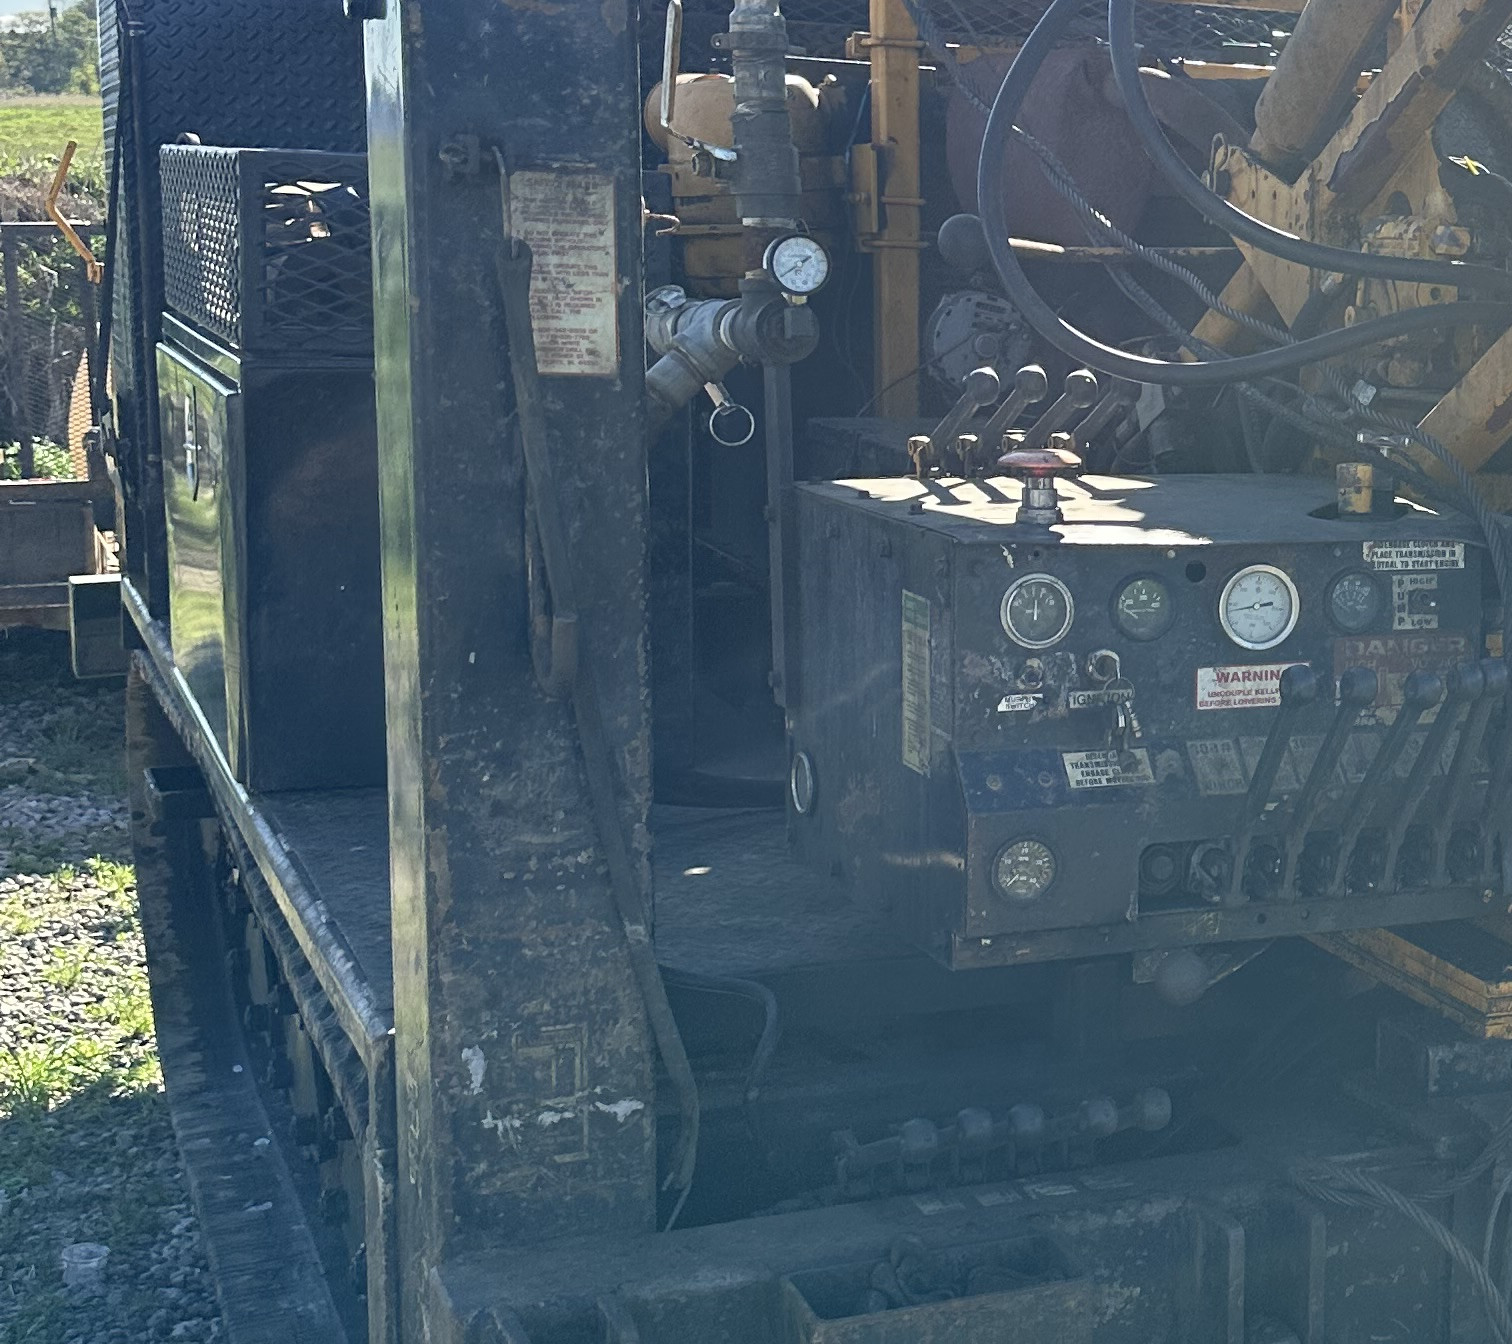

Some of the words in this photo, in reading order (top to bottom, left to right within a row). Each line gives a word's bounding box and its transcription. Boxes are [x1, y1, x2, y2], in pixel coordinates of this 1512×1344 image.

[1411, 560, 1433, 568] START
[1409, 577, 1435, 586] HIGH
[1411, 617, 1433, 627] LOW
[1215, 670, 1281, 683] WARNIN
